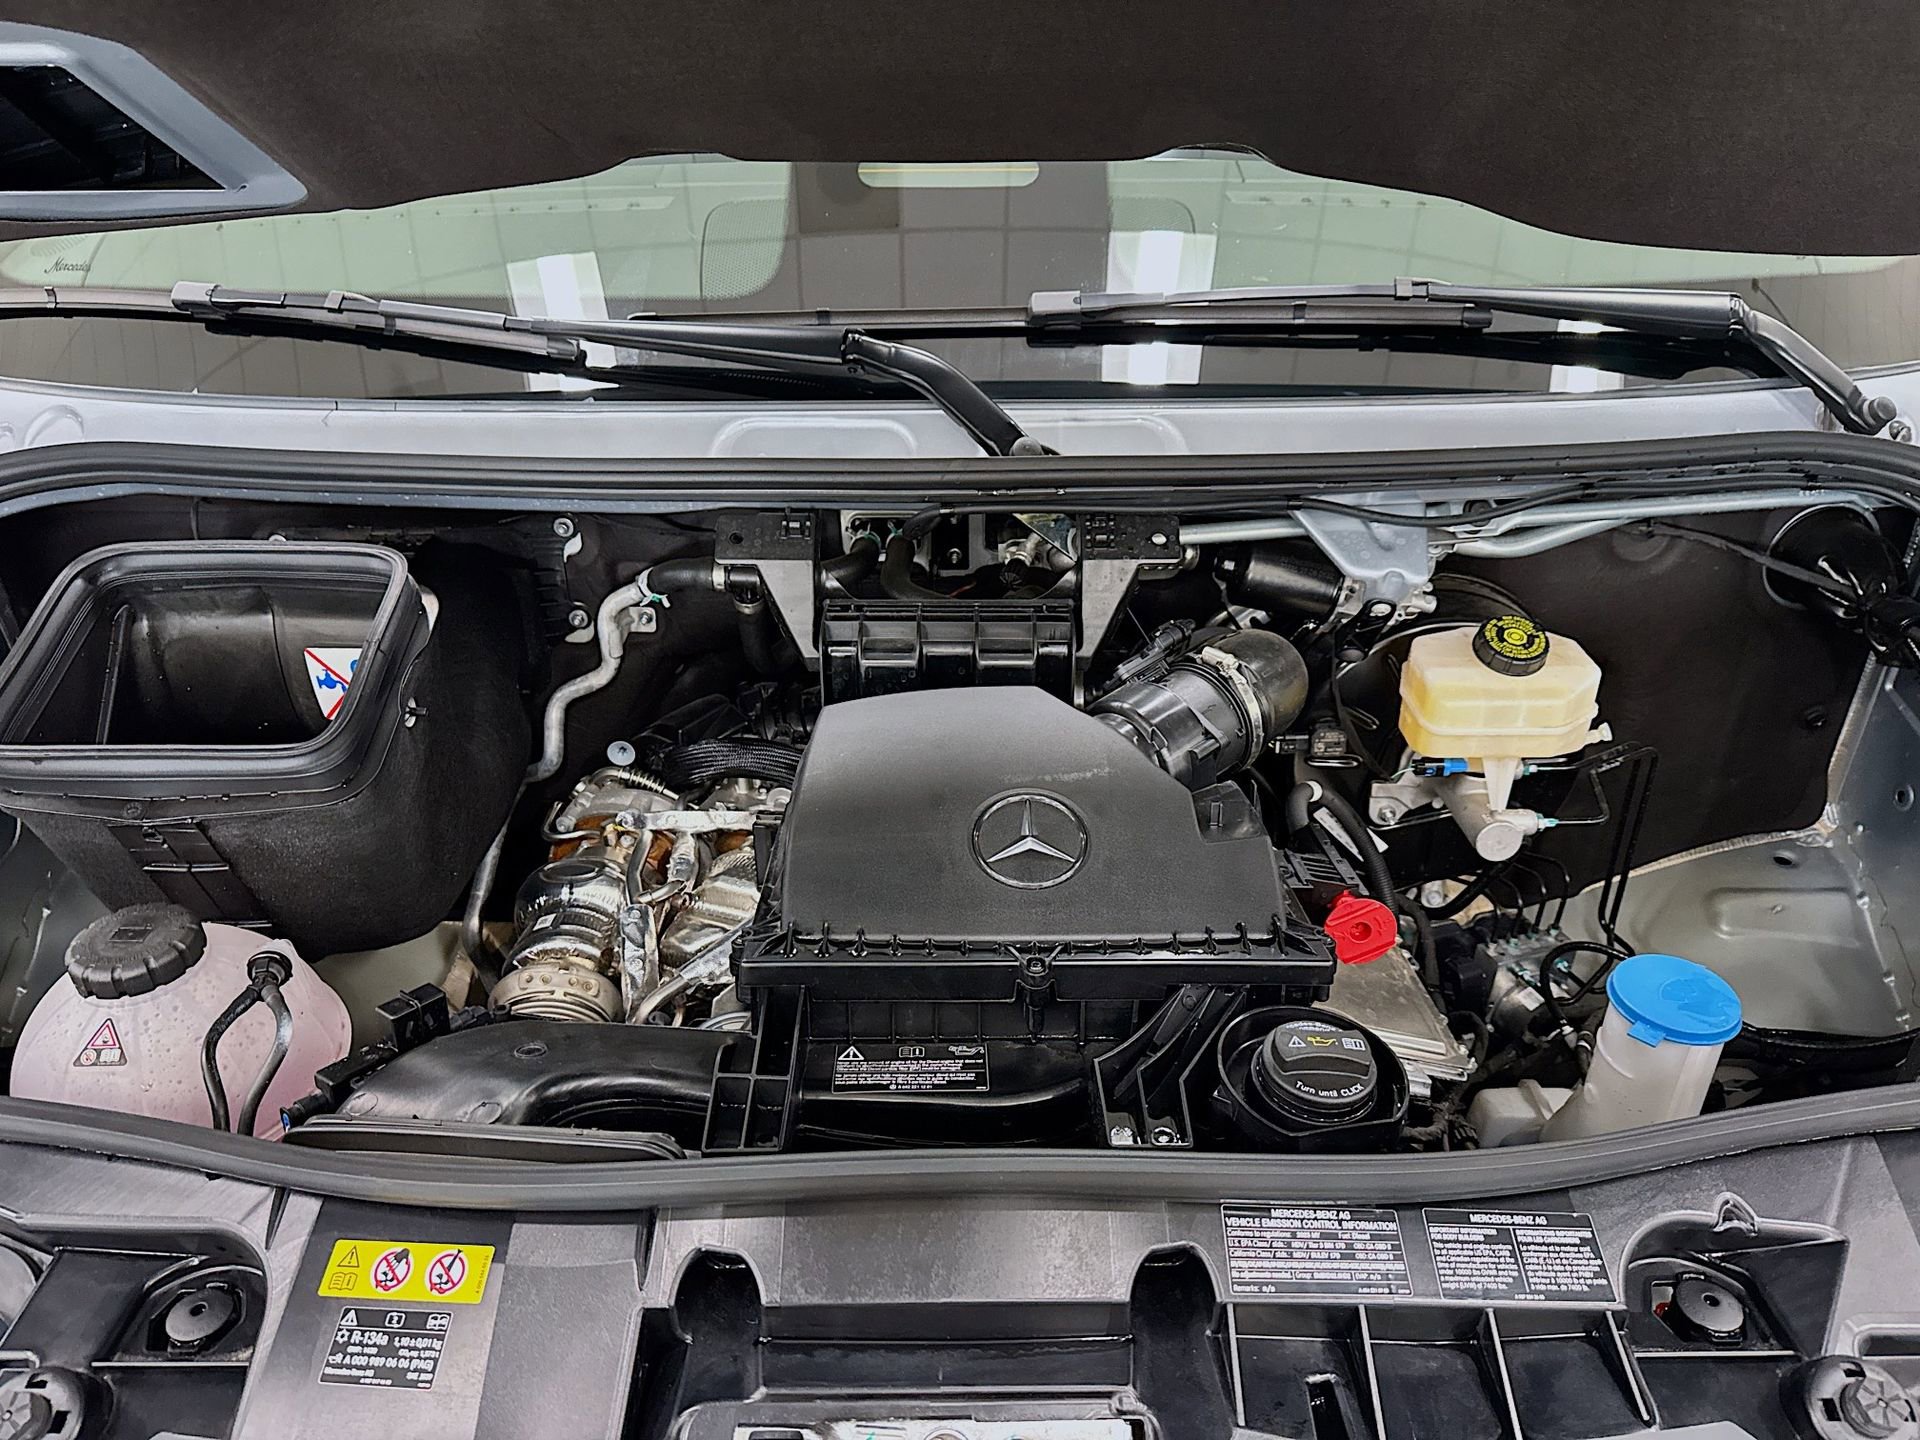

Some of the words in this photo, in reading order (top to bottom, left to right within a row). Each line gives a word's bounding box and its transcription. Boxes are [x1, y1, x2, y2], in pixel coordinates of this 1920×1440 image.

[44, 256, 90, 273] Mercedes
[1296, 1081, 1316, 1094] Turn
[1340, 1083, 1364, 1097] CLICK
[1271, 1209, 1338, 1220] MERCEDES-BENZ
[1339, 1211, 1351, 1220] AG
[1470, 1214, 1534, 1224] MERCEDES-BENZ
[1536, 1216, 1547, 1225] AG
[1225, 1217, 1261, 1226] VEHICLE
[1262, 1218, 1302, 1228] EMISSION
[1303, 1219, 1341, 1229] CONTROL
[1342, 1221, 1397, 1230] INFORMATION
[350, 1330, 389, 1345] R-134a
[343, 1355, 350, 1364] A
[351, 1355, 368, 1366] 000
[368, 1356, 386, 1367] 989
[385, 1357, 398, 1368] 06
[398, 1358, 410, 1368] 06
[410, 1359, 434, 1371] (PAG)
